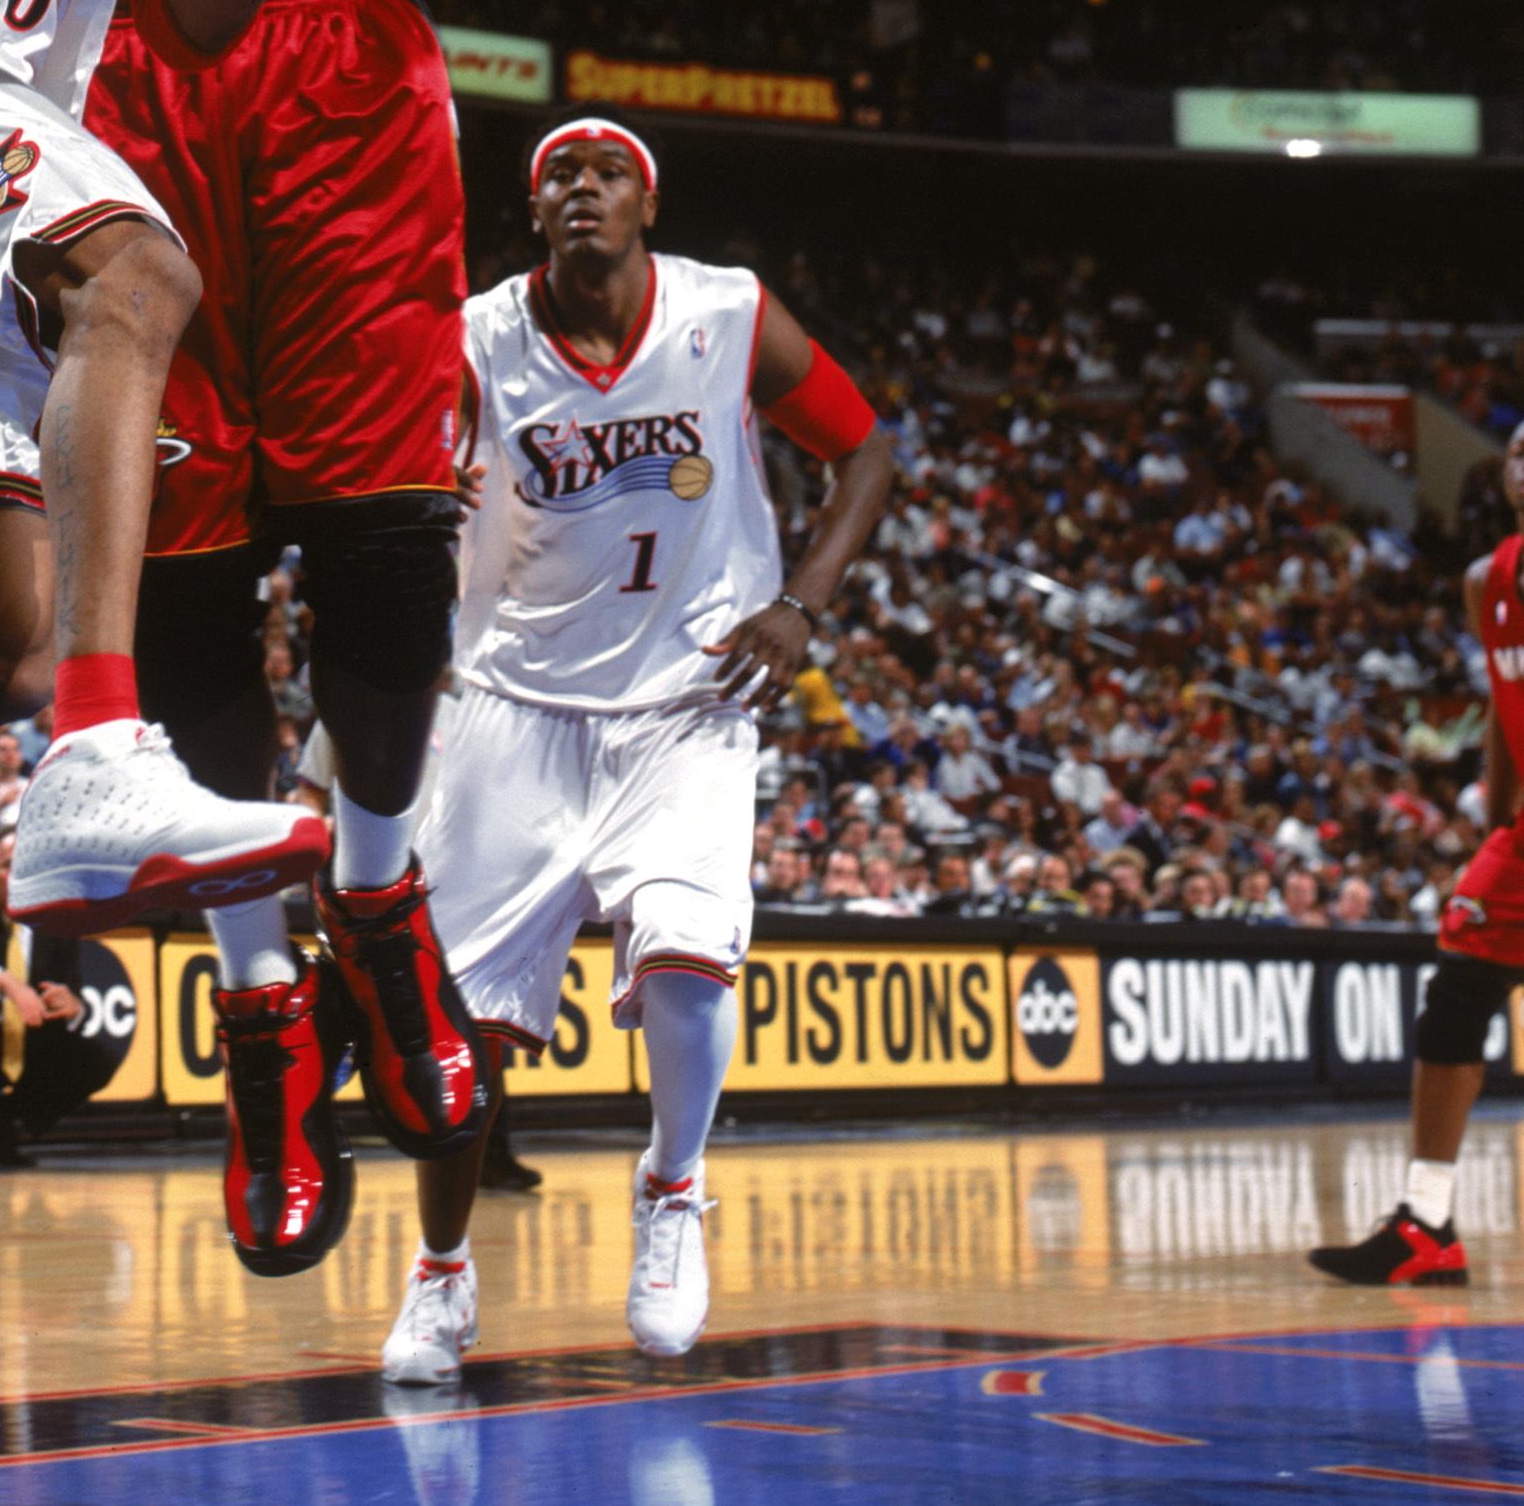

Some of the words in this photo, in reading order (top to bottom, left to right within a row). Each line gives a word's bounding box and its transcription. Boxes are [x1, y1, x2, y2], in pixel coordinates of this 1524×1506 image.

[618, 531, 658, 594] 1
[743, 961, 995, 1066] PISTONS
[1015, 981, 1080, 1035] abc
[1108, 958, 1314, 1065] SUNDAY
[1334, 962, 1403, 1064] ON
